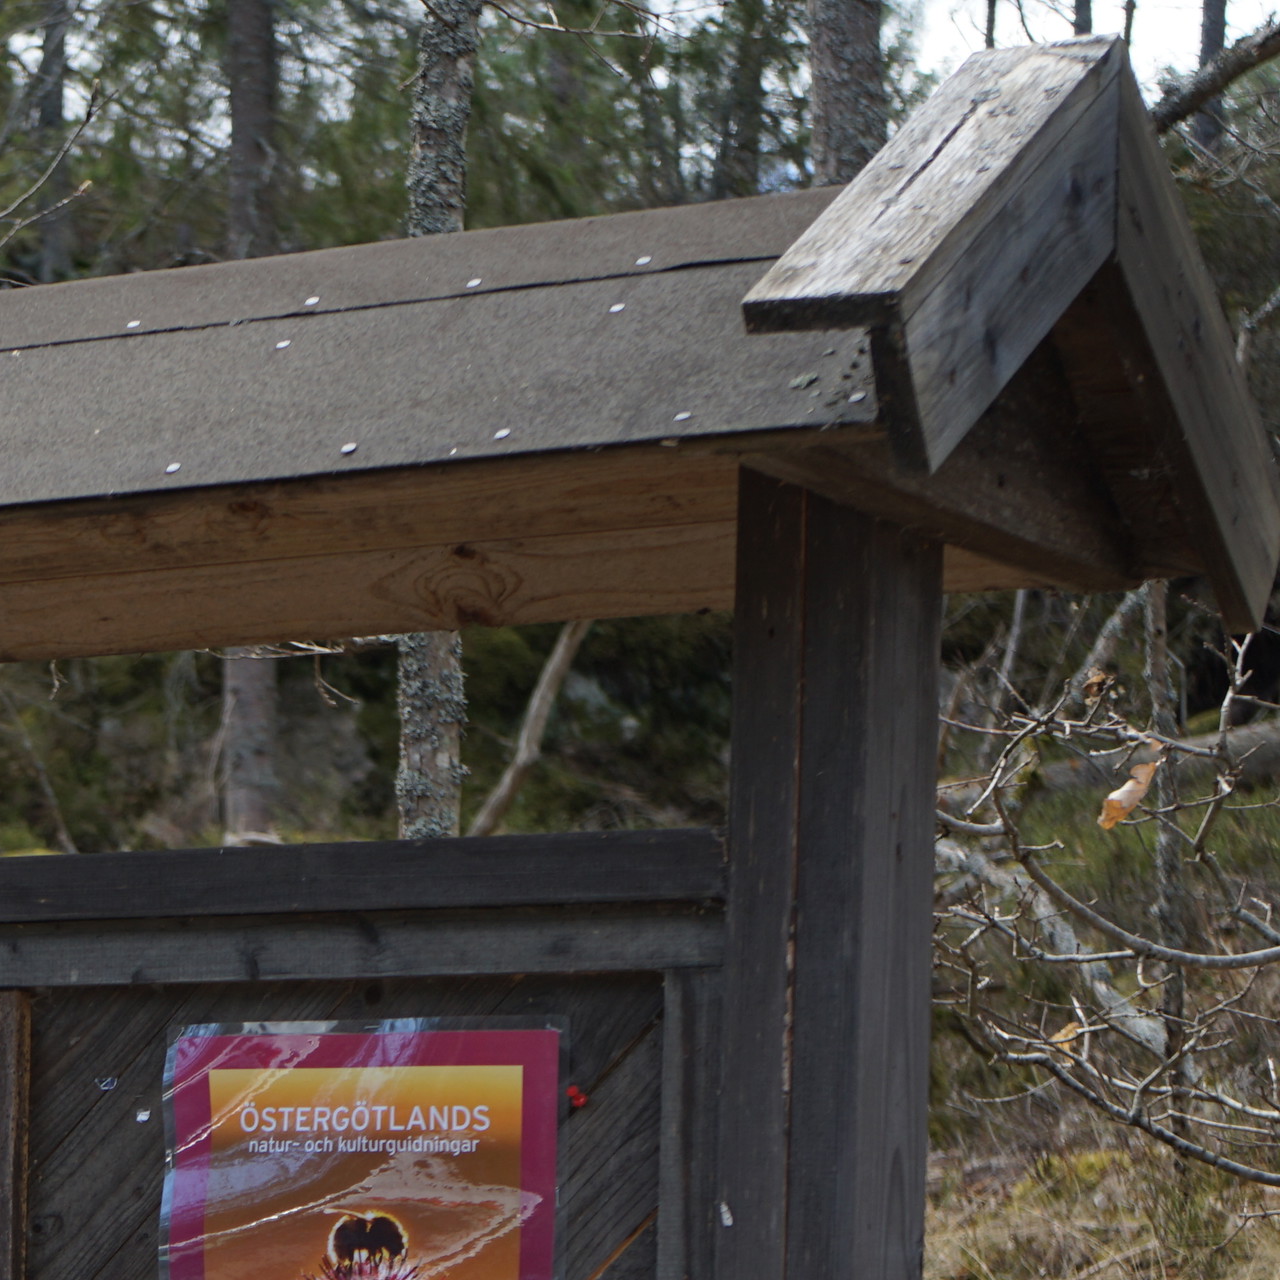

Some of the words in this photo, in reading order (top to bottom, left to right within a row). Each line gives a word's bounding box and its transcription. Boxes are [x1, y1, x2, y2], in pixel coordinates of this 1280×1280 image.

[240, 1101, 491, 1132] ÖSTERGÖTLANDS
[248, 1138, 300, 1153] natur-
[304, 1136, 333, 1153] och
[338, 1135, 480, 1156] kulturguidningar
